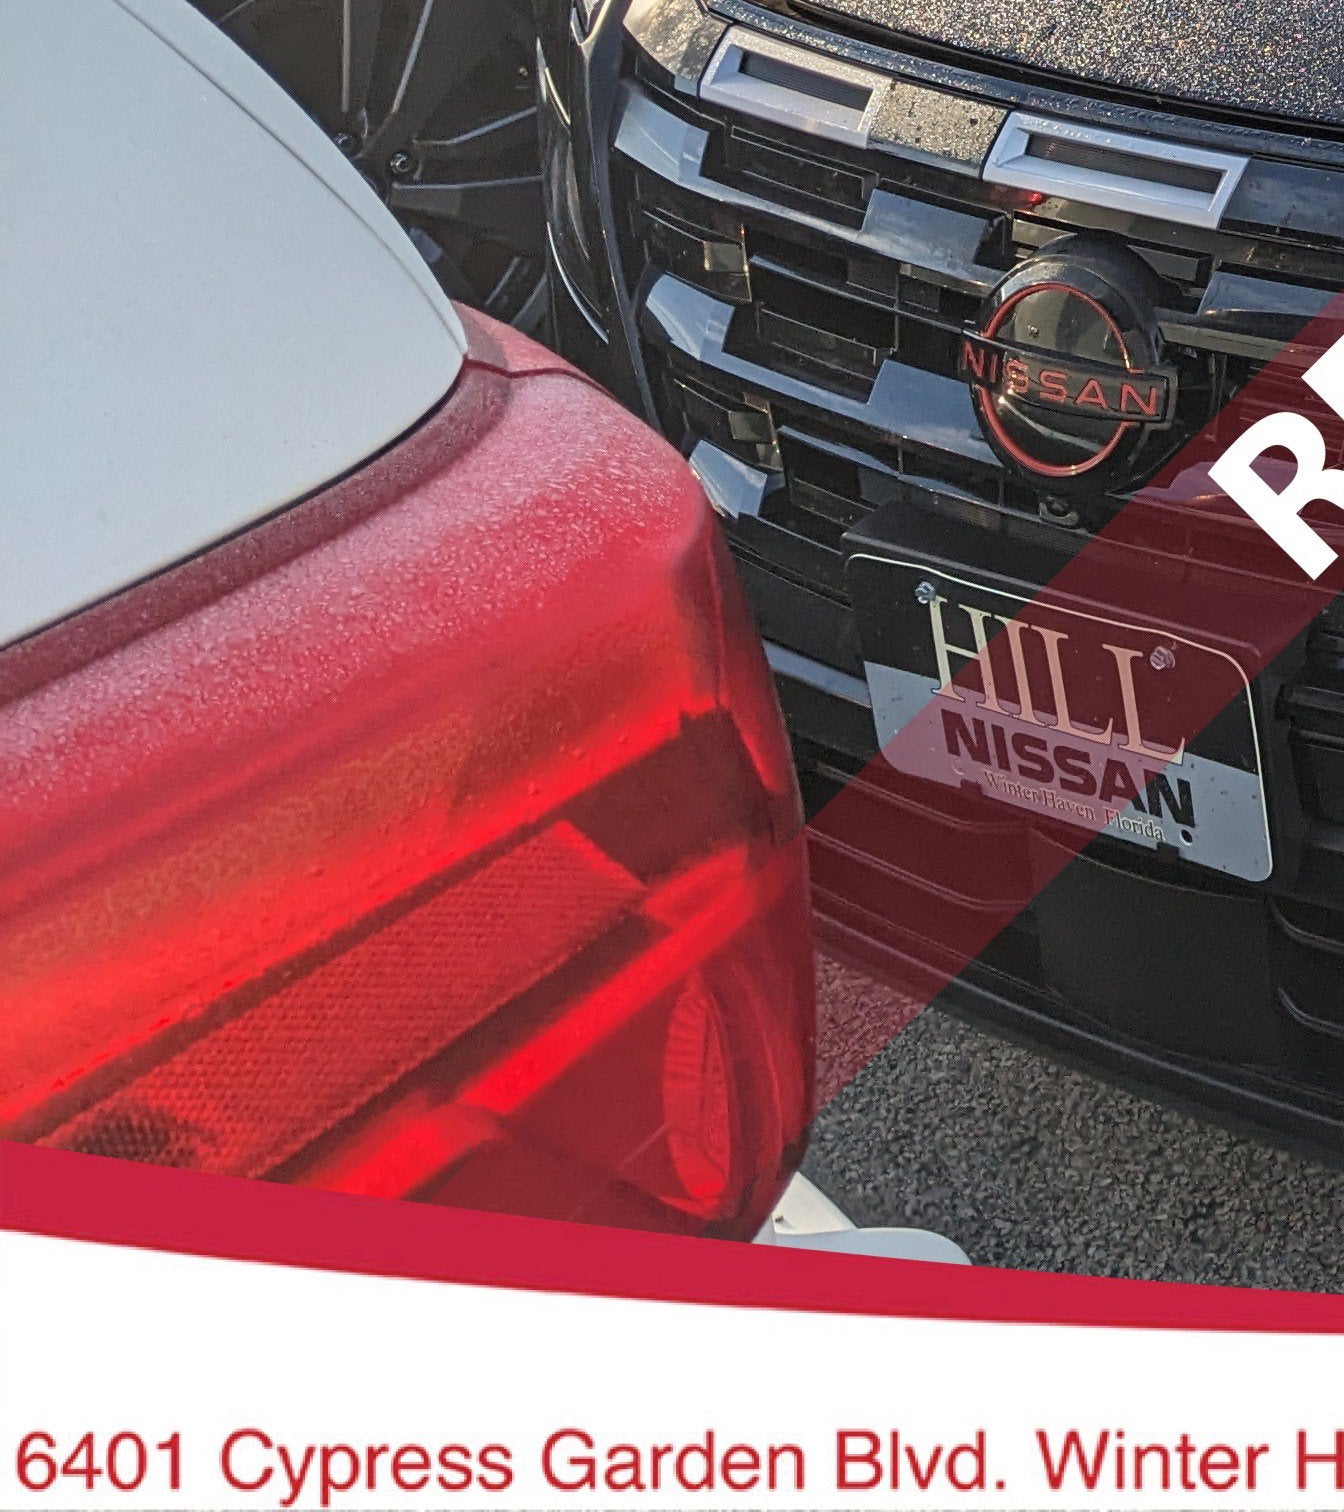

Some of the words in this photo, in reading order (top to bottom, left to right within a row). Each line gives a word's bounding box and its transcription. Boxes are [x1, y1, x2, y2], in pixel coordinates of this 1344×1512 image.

[961, 341, 1157, 415] NISSAN
[928, 594, 1186, 765] HILL
[941, 708, 1196, 827] NISSAN
[985, 770, 1038, 804] Winter
[1103, 808, 1166, 841] Florida
